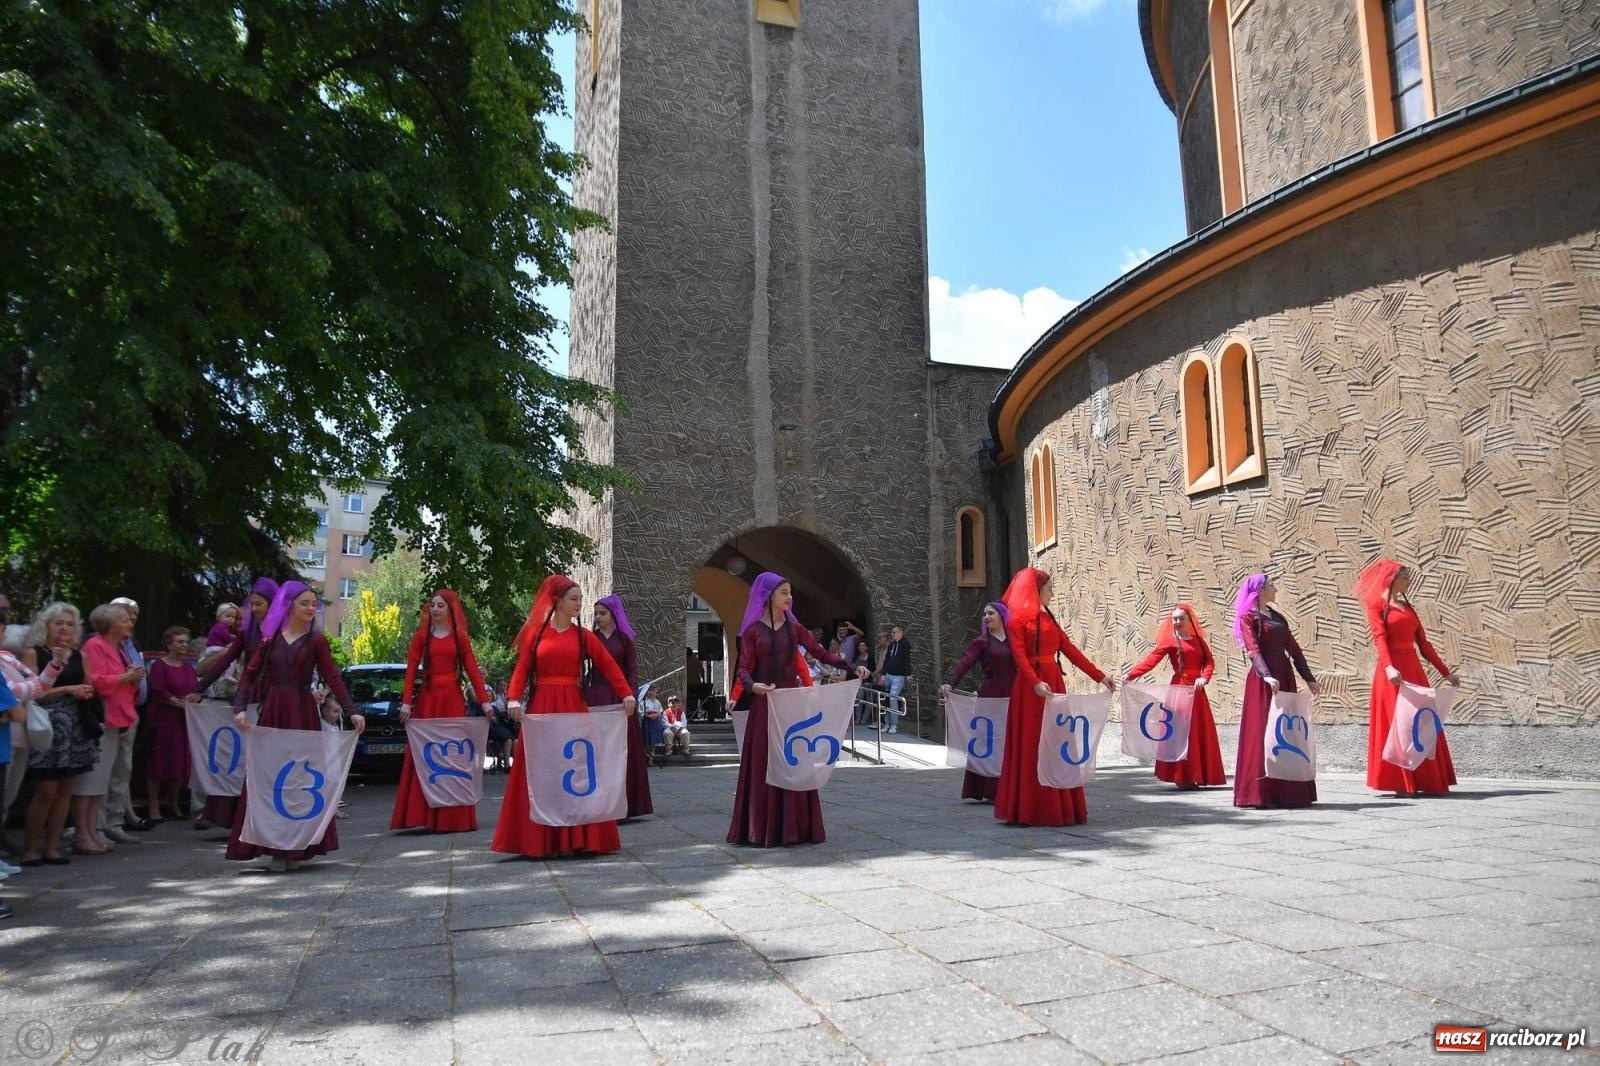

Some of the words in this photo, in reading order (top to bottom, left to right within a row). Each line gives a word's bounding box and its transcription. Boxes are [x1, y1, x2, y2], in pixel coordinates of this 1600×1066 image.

[783, 711, 840, 767] რ
[967, 715, 995, 759] ე
[1055, 712, 1091, 766] უ
[1139, 701, 1174, 742] ც
[207, 725, 242, 776] ი
[422, 738, 475, 785] ლ
[562, 738, 598, 797] ე
[272, 759, 325, 821] ც
